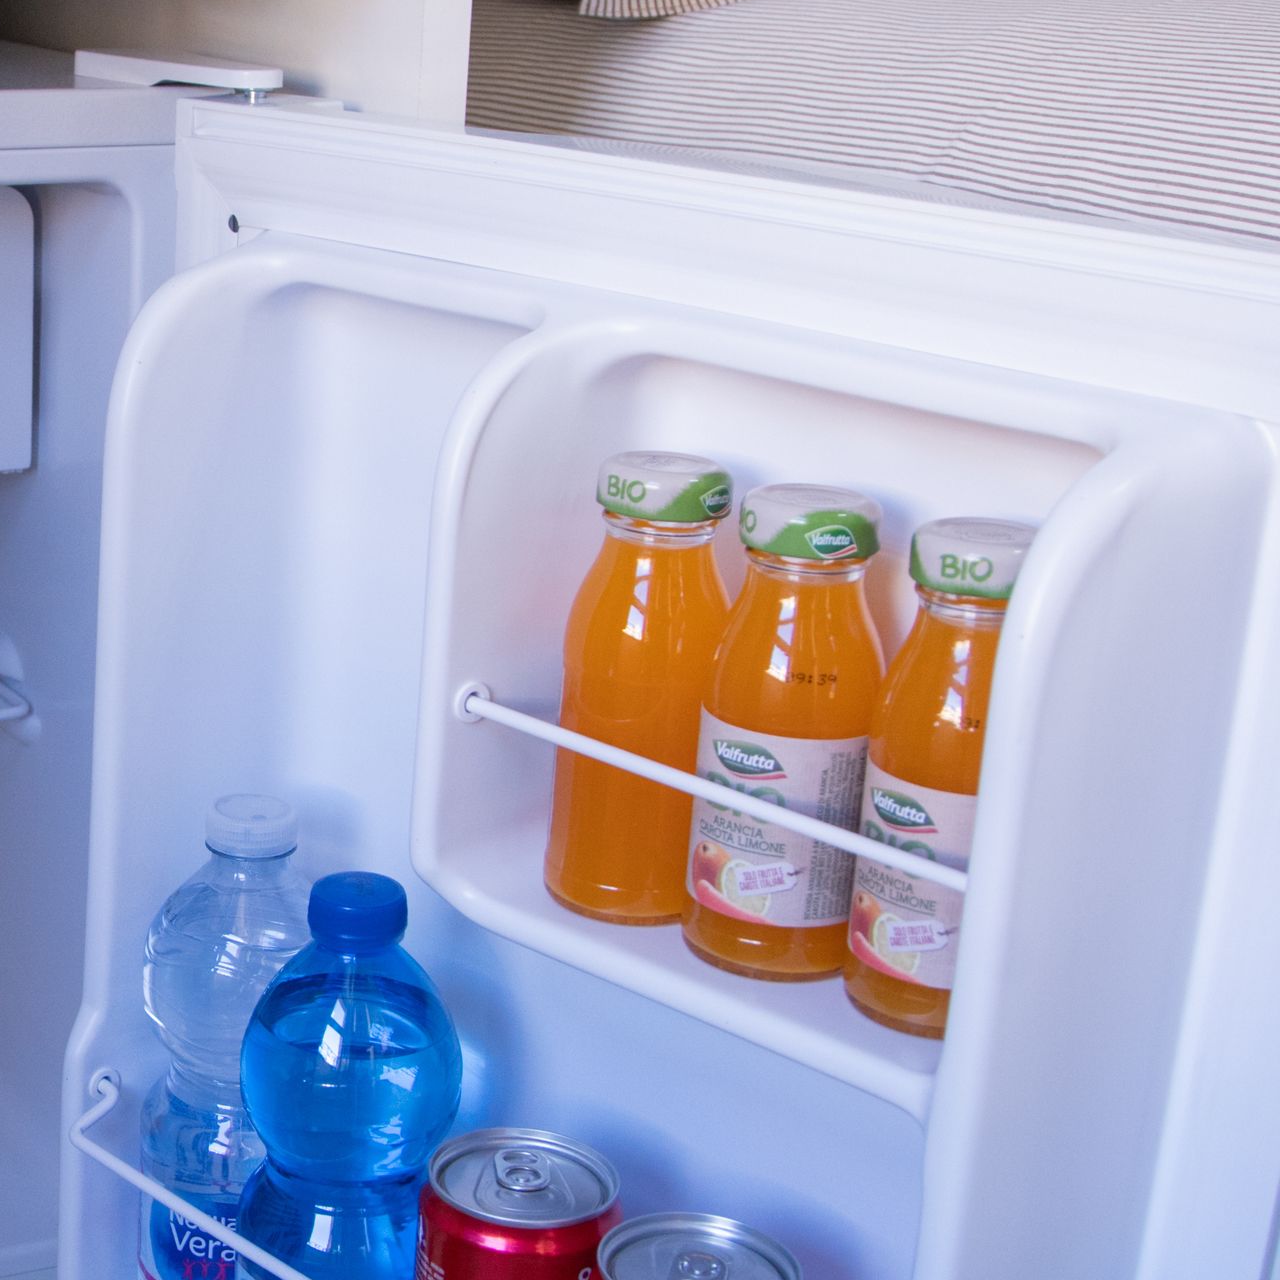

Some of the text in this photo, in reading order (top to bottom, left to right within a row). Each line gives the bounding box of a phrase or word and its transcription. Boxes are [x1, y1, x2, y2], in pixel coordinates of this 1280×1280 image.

[607, 474, 647, 504] BIO
[810, 531, 851, 547] Valfrutta
[940, 553, 994, 583] BIO
[716, 740, 776, 770] Valfrutta
[873, 788, 927, 824] Valfrutta
[713, 815, 764, 839] ARANCIA
[738, 835, 786, 855] LIMONE
[867, 866, 914, 894] ARANCIA
[889, 888, 937, 912] LIMONE
[169, 1221, 238, 1262] Vera
